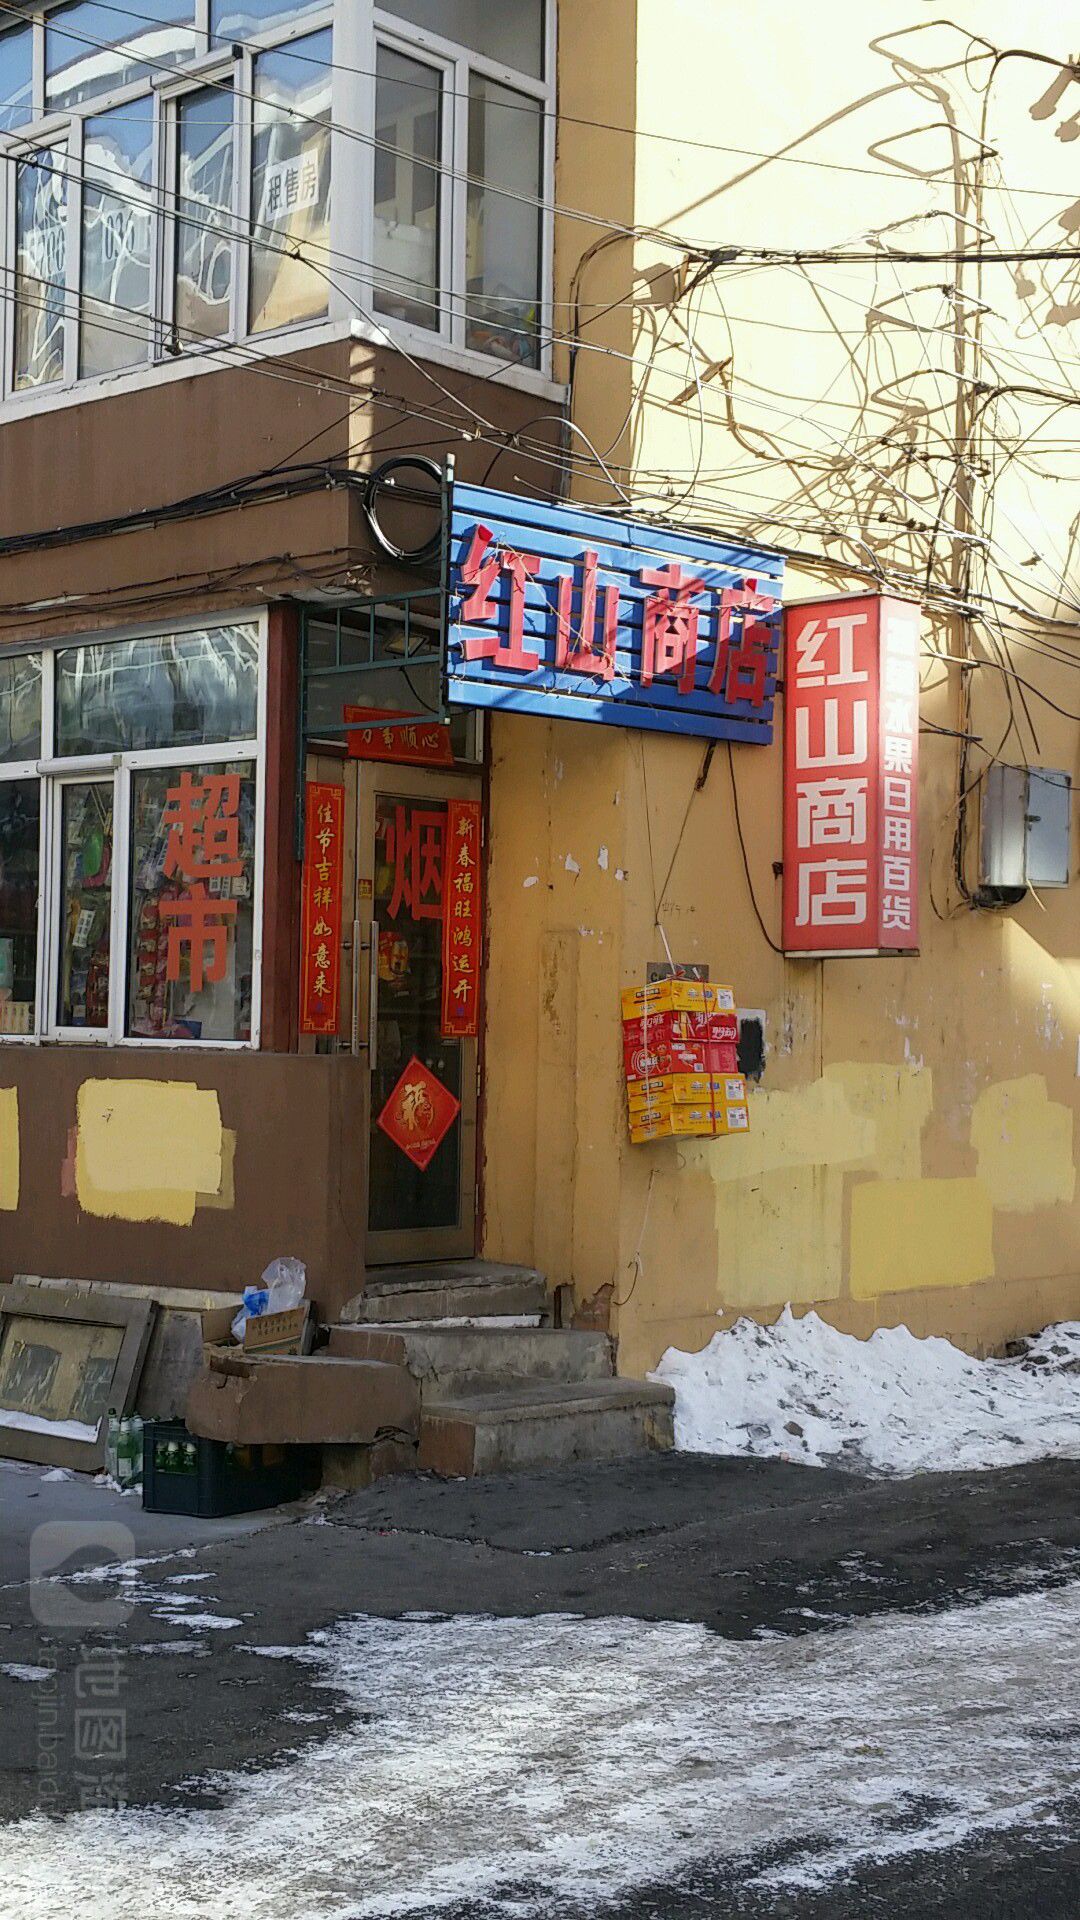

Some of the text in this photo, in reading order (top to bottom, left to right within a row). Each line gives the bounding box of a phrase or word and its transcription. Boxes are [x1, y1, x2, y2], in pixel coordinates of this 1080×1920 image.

[267, 160, 316, 213] 租售房
[460, 523, 775, 709] 红山商店
[385, 805, 448, 921] 烟
[794, 613, 869, 927] 红山商店
[159, 771, 246, 993] 超市
[312, 802, 336, 998] 佳节吉祥如意来
[452, 816, 476, 1003] 新春福旺鸿运开
